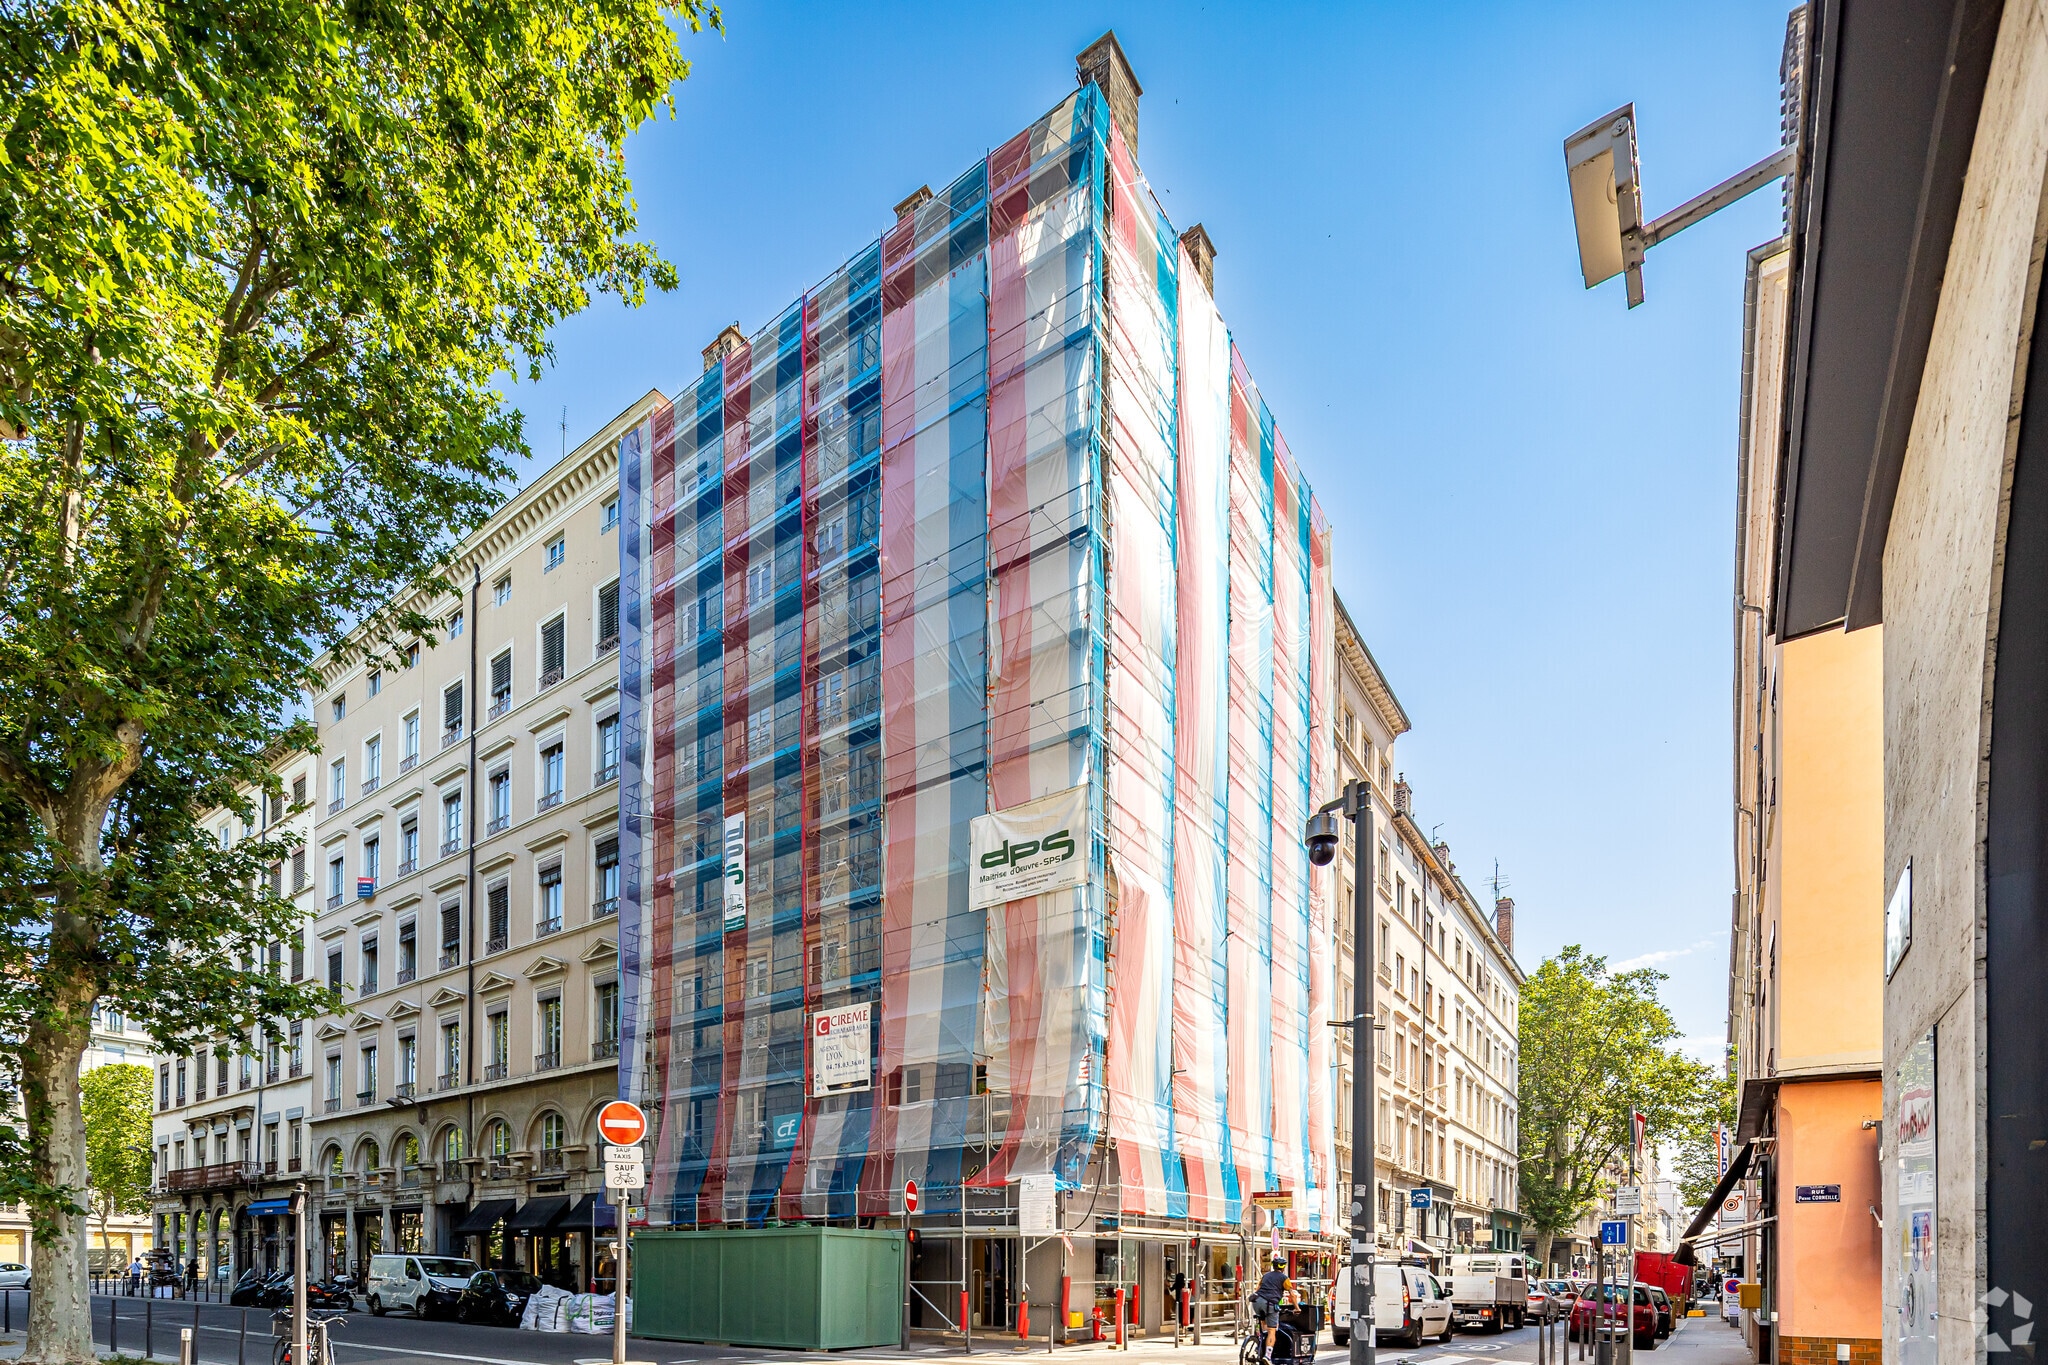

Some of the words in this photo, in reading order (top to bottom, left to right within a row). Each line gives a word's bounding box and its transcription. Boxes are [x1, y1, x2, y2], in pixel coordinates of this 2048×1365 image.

[980, 829, 1075, 869] dps
[830, 1009, 868, 1027] CIREME
[825, 1050, 843, 1062] LYON
